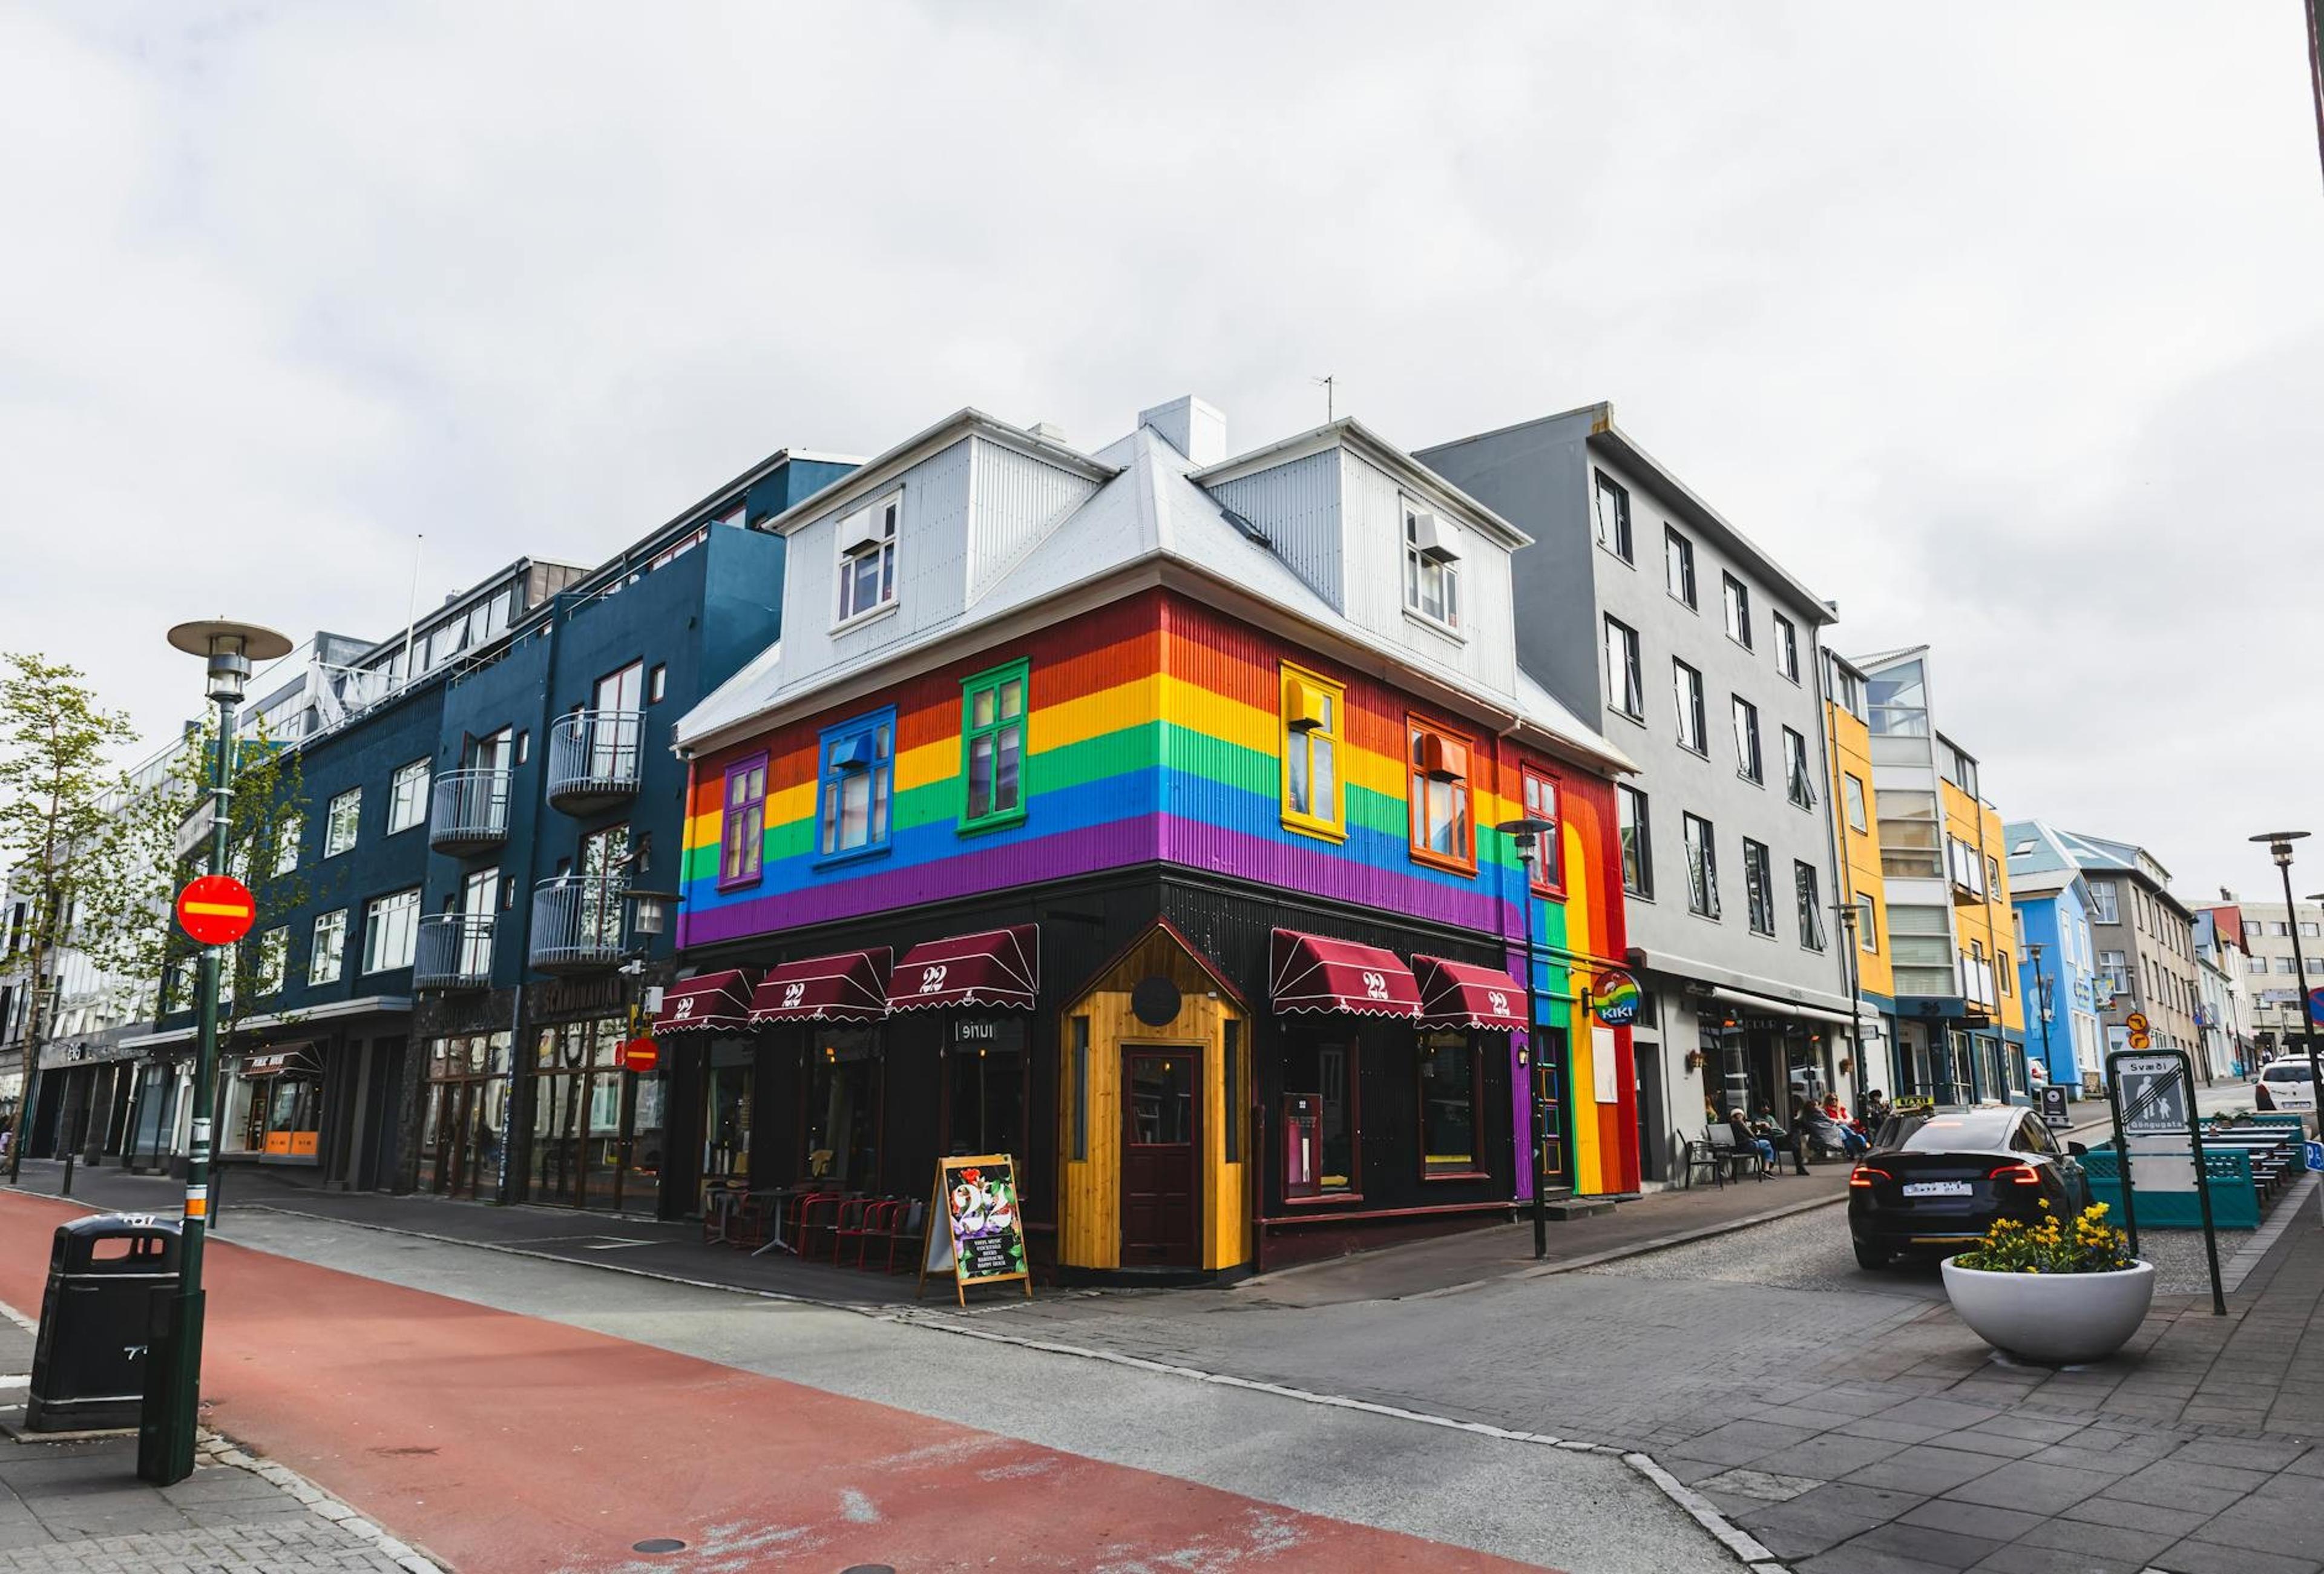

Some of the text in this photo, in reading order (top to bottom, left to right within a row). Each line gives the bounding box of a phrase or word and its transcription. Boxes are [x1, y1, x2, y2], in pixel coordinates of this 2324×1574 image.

[919, 965, 947, 993] 22
[1363, 971, 1388, 999] 22
[782, 983, 805, 1007] 22
[1488, 990, 1510, 1016] 22
[674, 997, 694, 1019] 22
[1601, 1006, 1633, 1019] KIKI
[2130, 1062, 2167, 1071] Svæði
[2306, 1145, 2314, 1165] P
[954, 1182, 1012, 1232] 22
